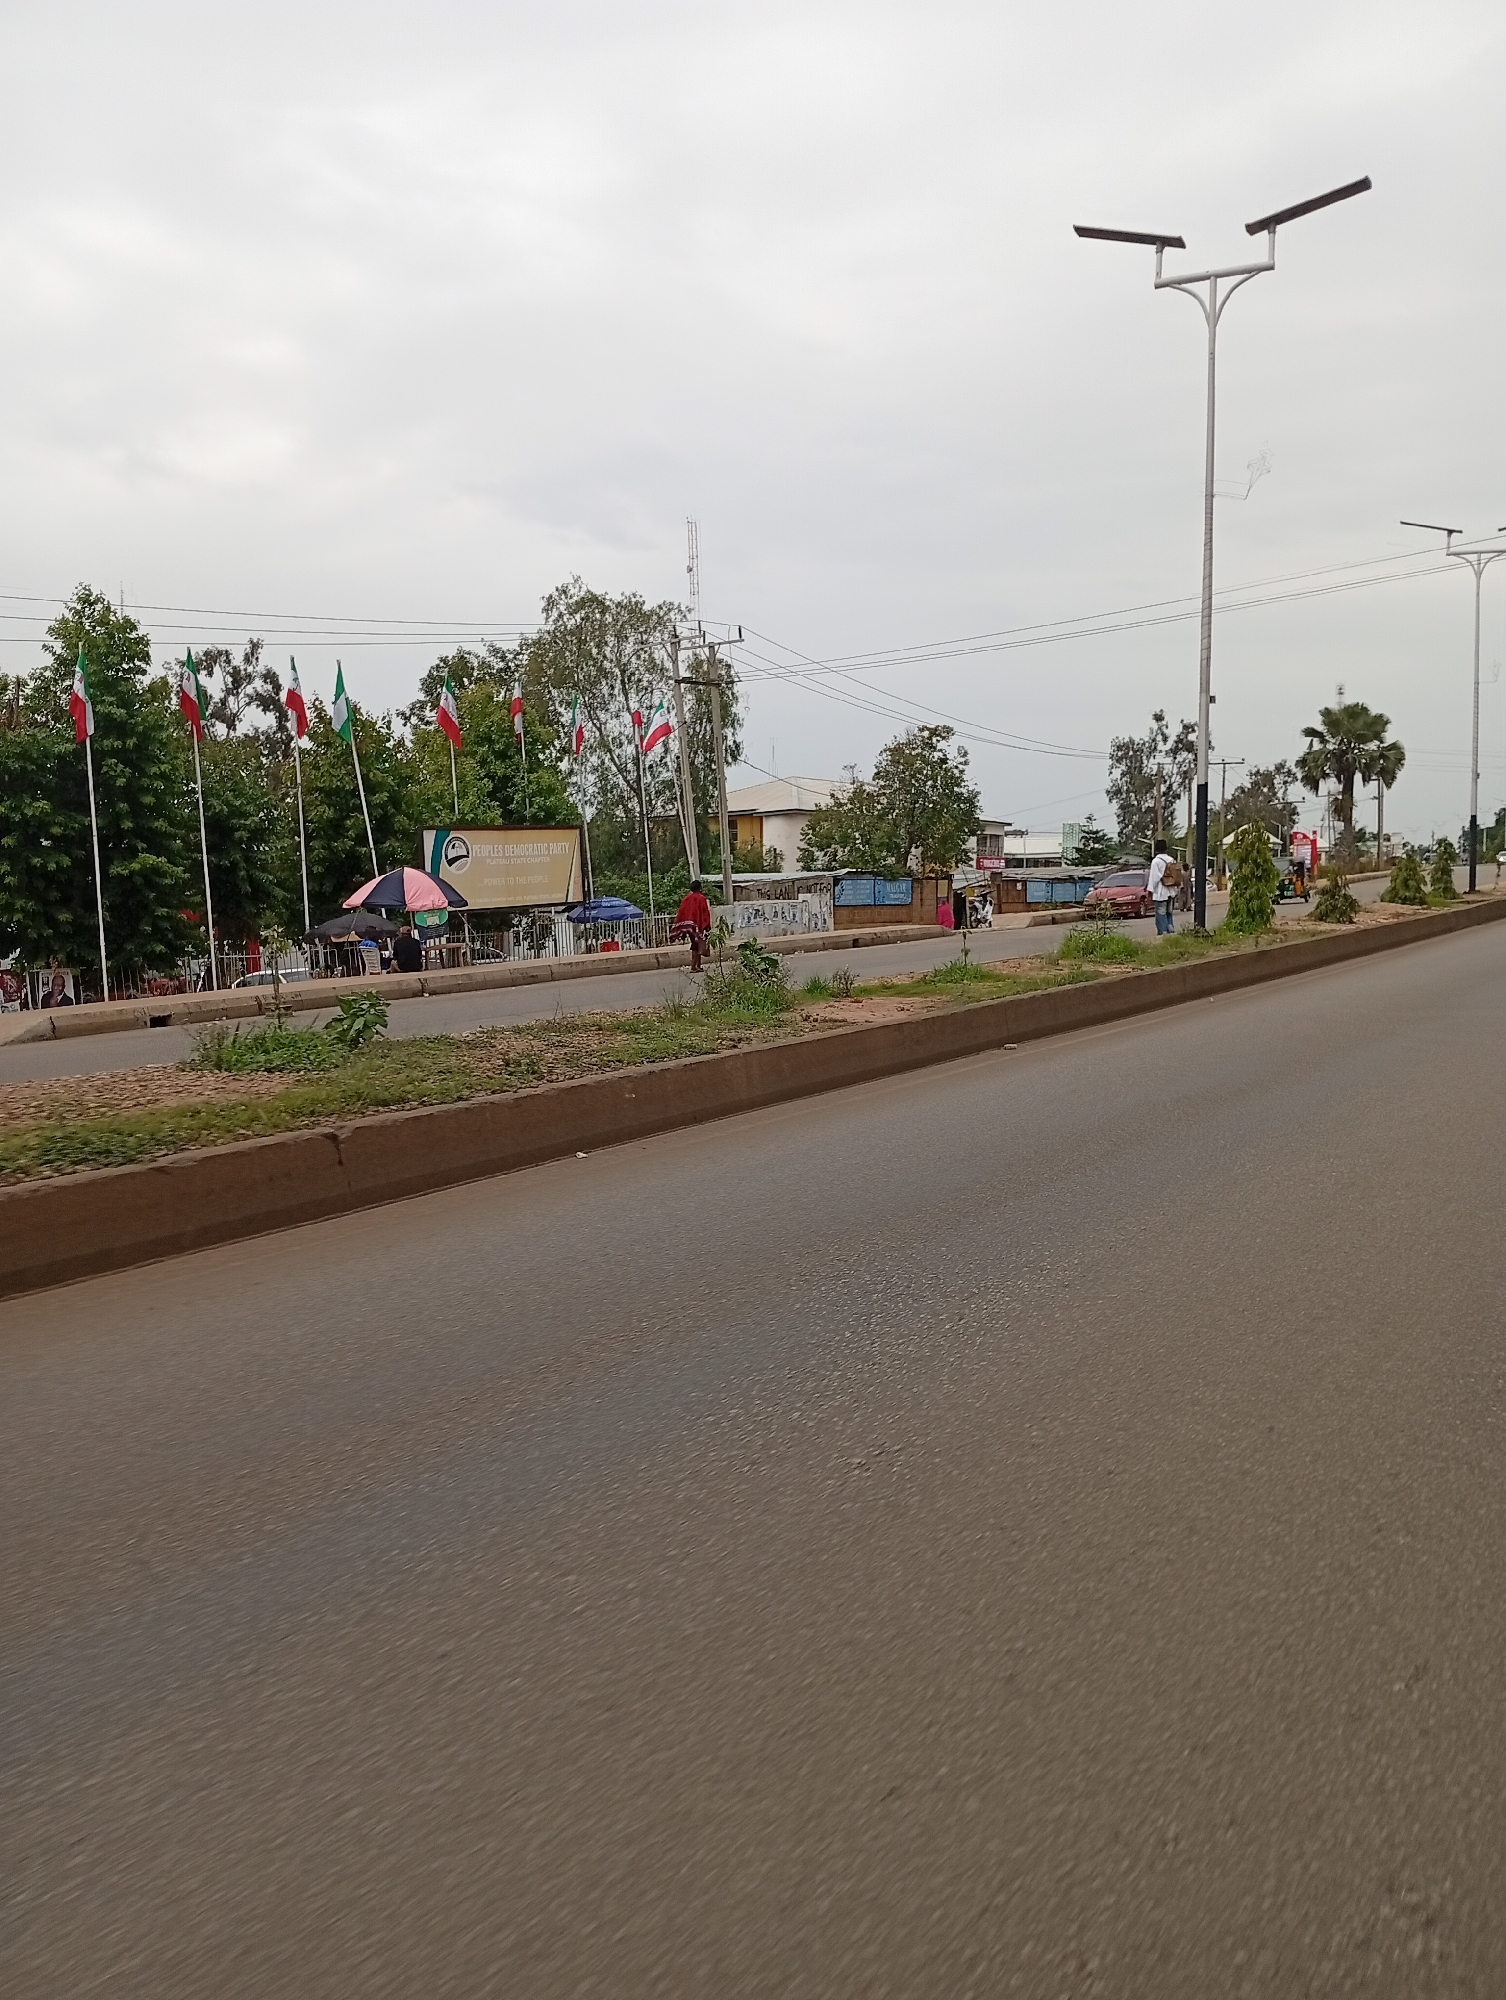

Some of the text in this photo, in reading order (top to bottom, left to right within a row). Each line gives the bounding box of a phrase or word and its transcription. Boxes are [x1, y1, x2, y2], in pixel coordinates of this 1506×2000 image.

[472, 844, 503, 857] PEOPLES
[504, 843, 548, 857] DEMOCRATIC
[549, 842, 570, 855] PARTY
[510, 857, 527, 865] STATE
[527, 856, 550, 864] CHAPTER
[506, 877, 514, 885] TO
[515, 876, 527, 885] THE
[527, 874, 549, 884] PEOPLE
